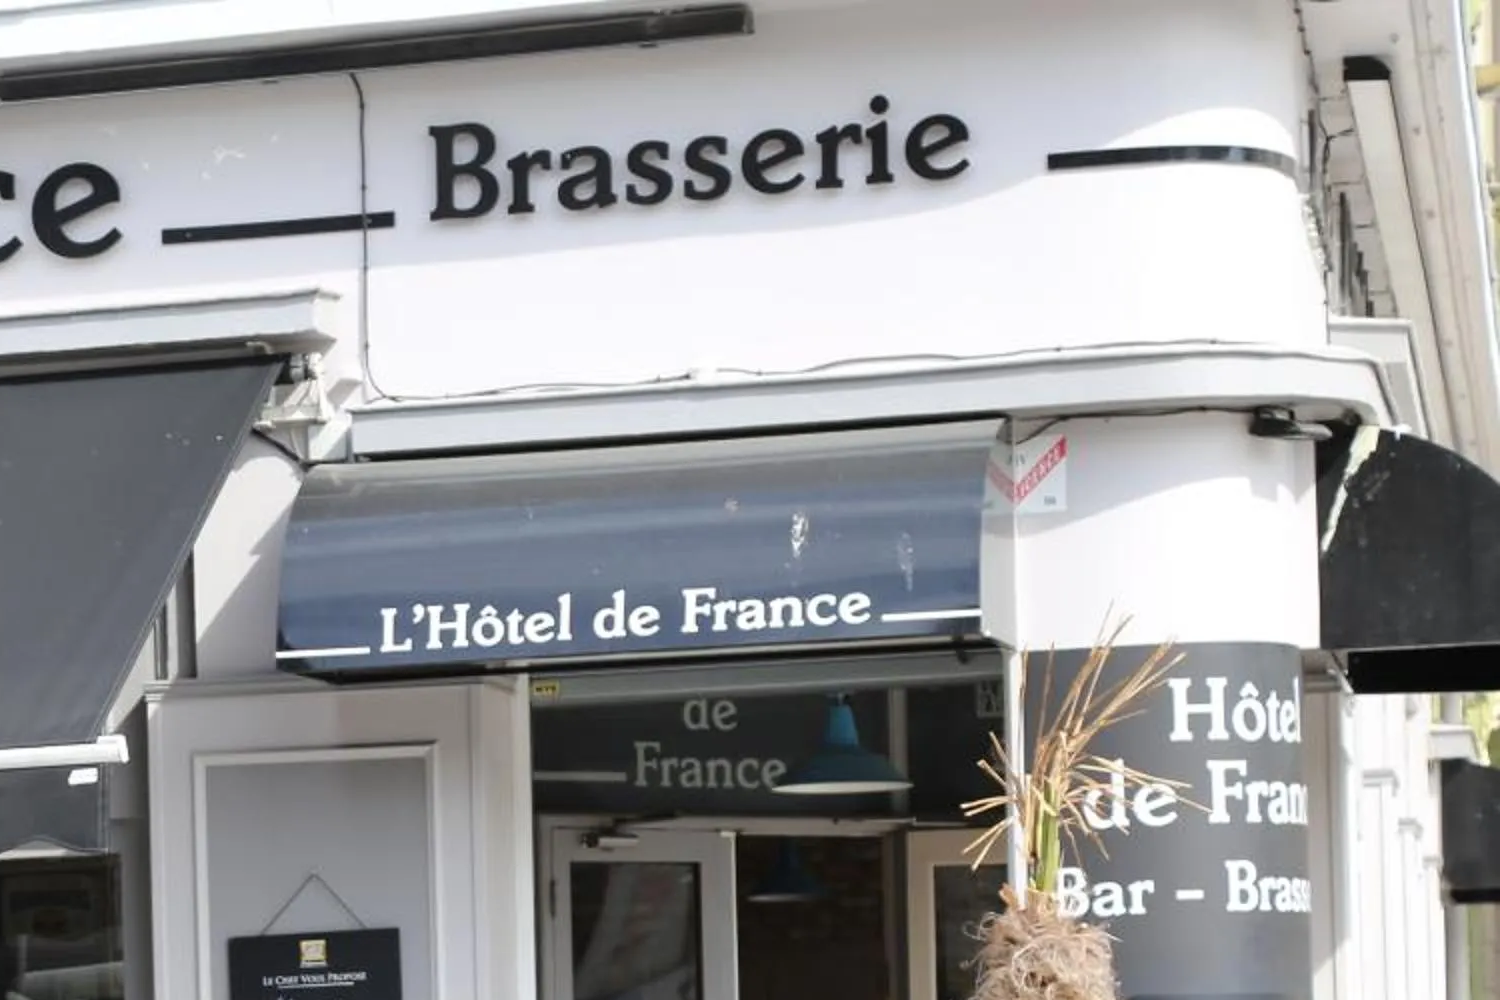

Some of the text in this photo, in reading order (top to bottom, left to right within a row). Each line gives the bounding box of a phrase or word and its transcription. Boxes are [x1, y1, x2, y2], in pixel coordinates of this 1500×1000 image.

[428, 94, 970, 222] Brasserie
[380, 586, 873, 653] L'Hôtel de France
[683, 699, 739, 731] de
[1167, 676, 1302, 743] Hôtel
[633, 740, 788, 791] France
[1083, 758, 1179, 829] de
[1056, 866, 1156, 918] Bar
